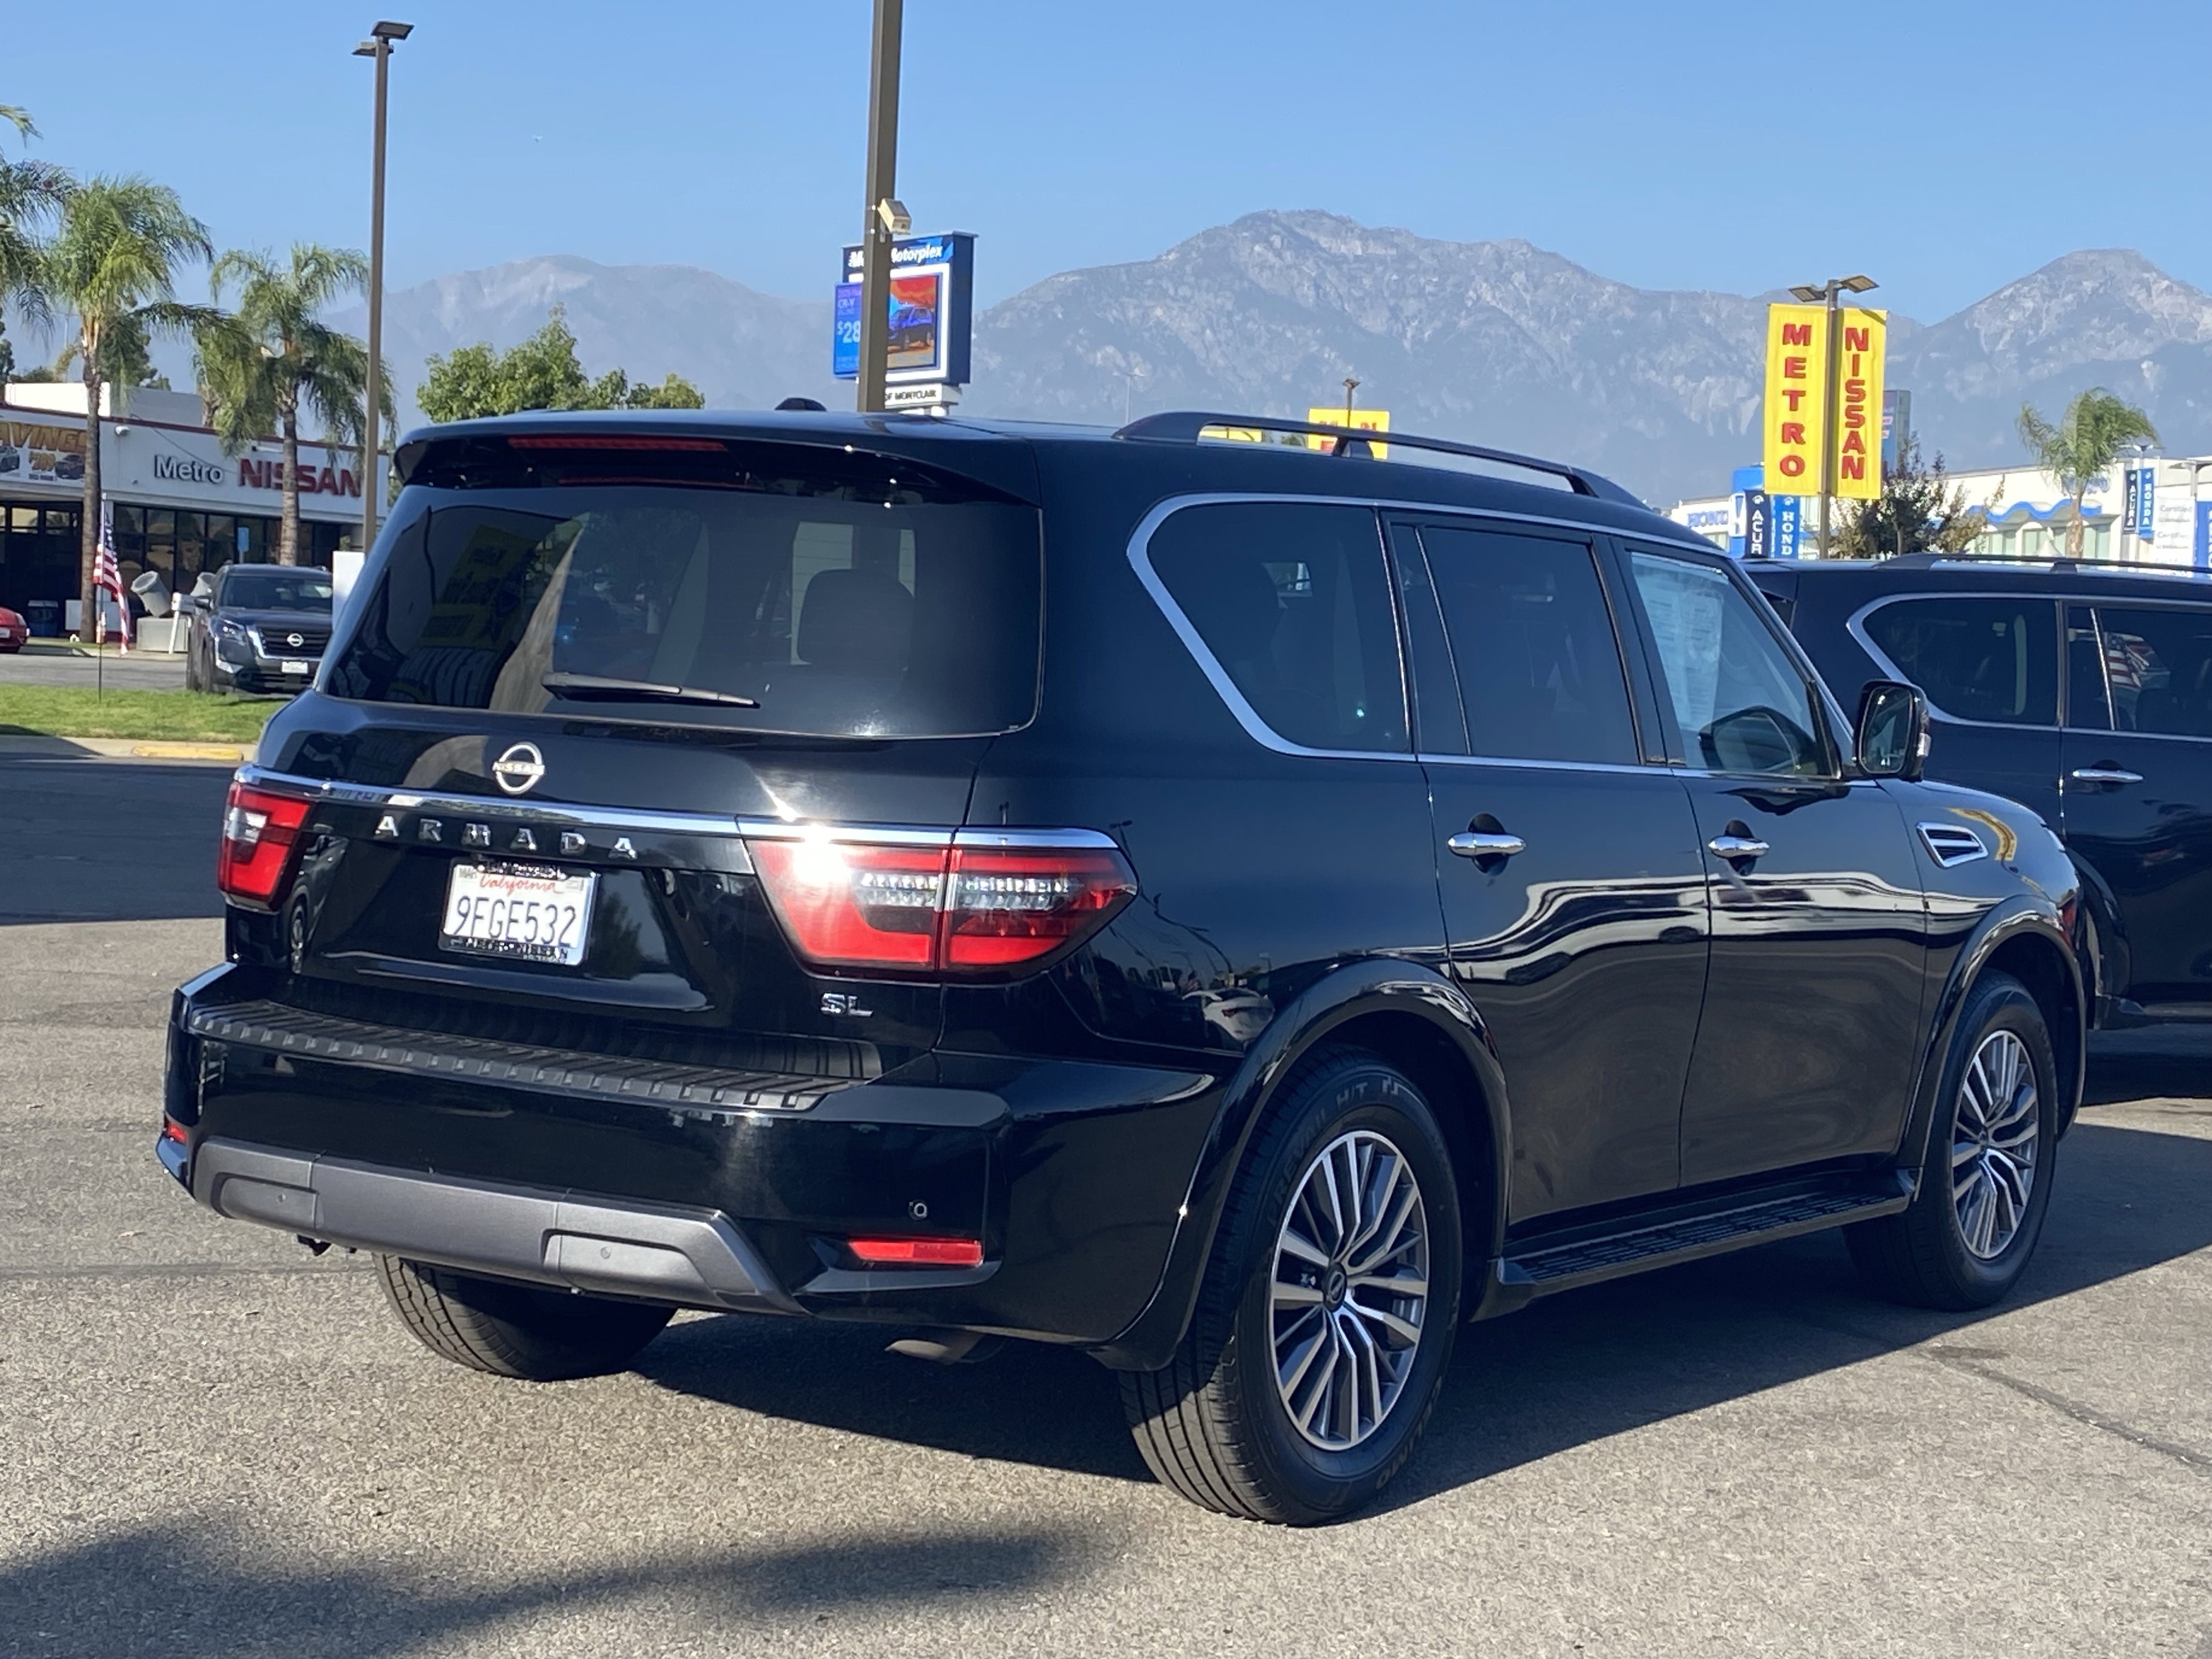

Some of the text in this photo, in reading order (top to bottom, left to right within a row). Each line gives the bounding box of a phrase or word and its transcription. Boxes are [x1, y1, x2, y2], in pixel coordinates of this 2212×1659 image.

[1780, 323, 1812, 477] METRO
[1841, 327, 1869, 480] NISSAN
[154, 455, 224, 484] Metro
[2126, 484, 2136, 527] ACURA
[2142, 483, 2152, 526] HONDA
[1751, 510, 1764, 555] ACUR
[1781, 511, 1795, 555] HOND
[375, 816, 638, 859] ARMADA
[453, 895, 576, 948] 9FGE532
[821, 992, 874, 1017] SL
